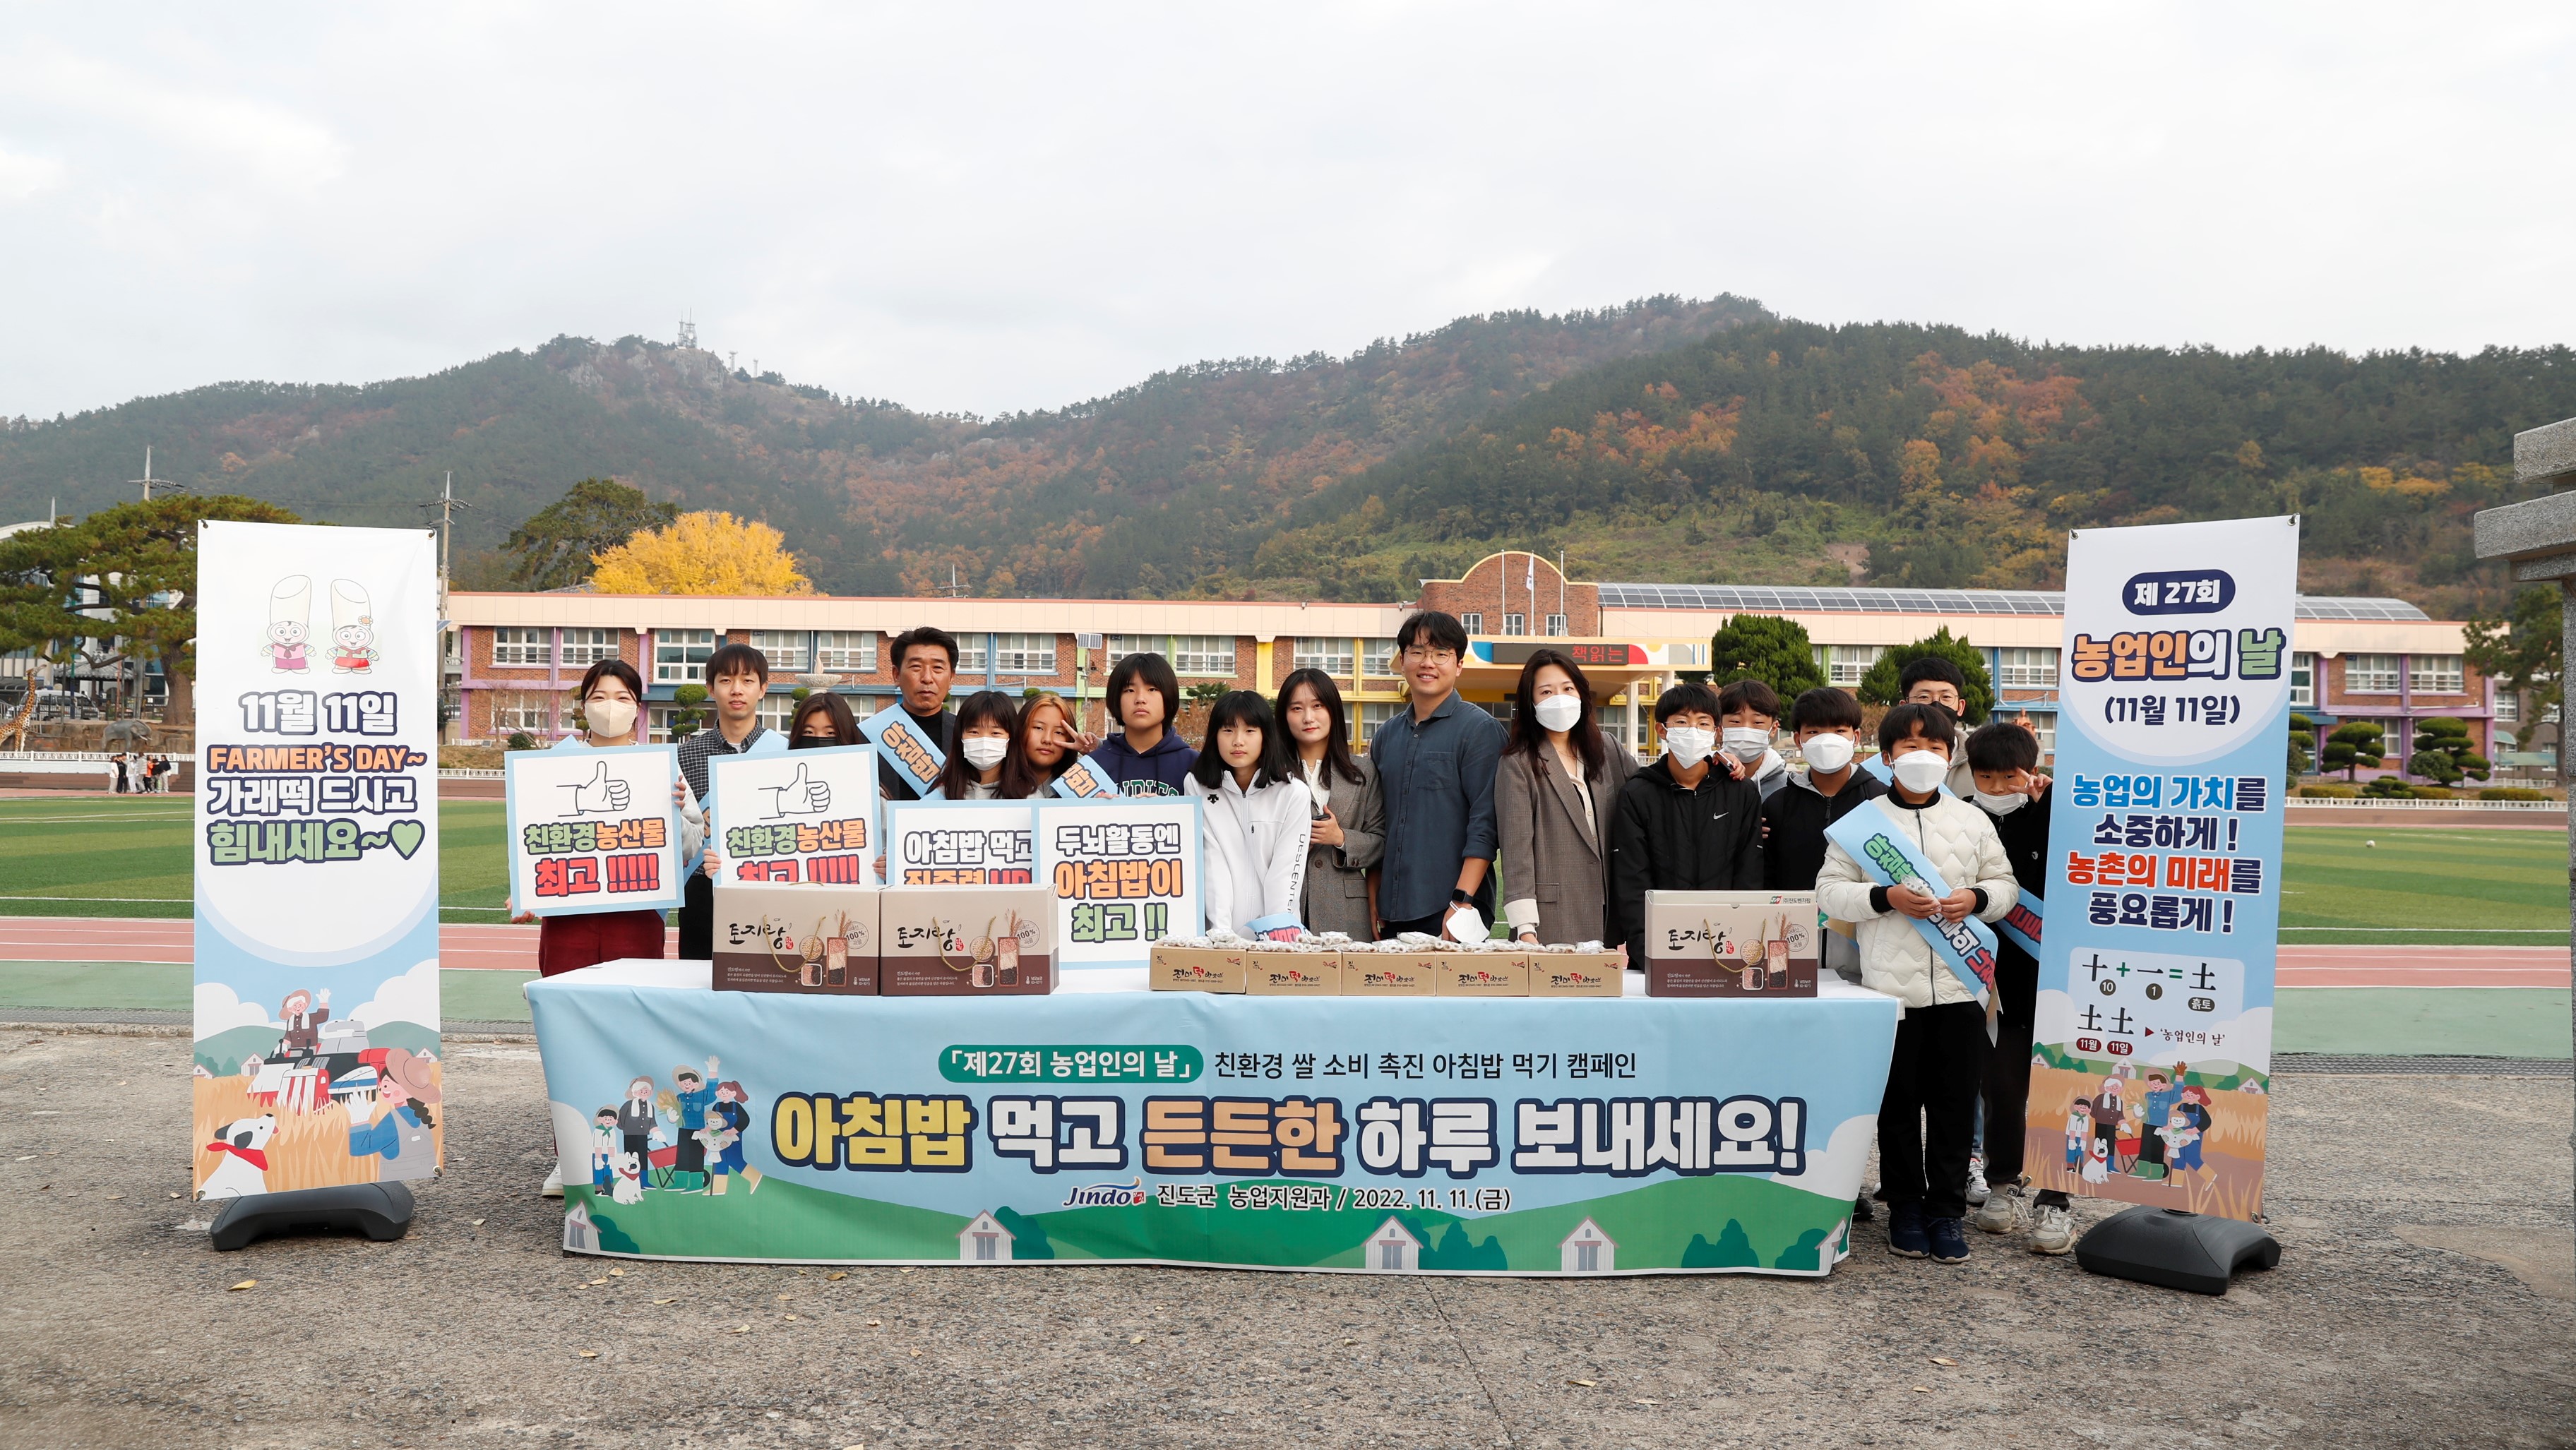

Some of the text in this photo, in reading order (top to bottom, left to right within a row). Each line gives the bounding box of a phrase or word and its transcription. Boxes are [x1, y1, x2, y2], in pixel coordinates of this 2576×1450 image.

[2134, 580, 2220, 606] 제 27회
[2072, 628, 2286, 682] 농업인의 날
[239, 690, 397, 735] 11월 11일
[2104, 695, 2241, 725] (11월 11일)
[208, 742, 427, 773] FARMER'S DAY~
[881, 721, 941, 784] 아침밥
[208, 777, 417, 815] 가래떡 드시고
[2072, 774, 2266, 812] 농업의 가치를
[523, 817, 667, 855] 친환경농산물
[726, 817, 867, 858] 친환경농산물
[904, 829, 986, 865] 아침밥
[1057, 823, 1181, 856] 두뇌활동엔
[2092, 814, 2217, 851] 소중하게
[535, 853, 660, 897] 최고 !!!!!
[1054, 859, 1183, 899] 아침밥이
[2066, 851, 2262, 895] 농촌의 미래를
[1071, 903, 1168, 943] 최고 !!
[2088, 892, 2214, 933] 풍요롭게
[846, 930, 864, 940] 100%
[1017, 929, 1036, 940] 100%
[1787, 933, 1805, 943] 100%
[2101, 981, 2158, 997] 10 1
[2190, 998, 2212, 1012] 흙토
[2080, 1038, 2129, 1054] 11월 11일
[951, 1050, 1637, 1079] 「제27회 농업인의 날」 친환경 쌀 소비 촉진 아침밥 먹기 캠페인
[771, 1091, 1807, 1179] 아침밥 먹고 든든한 하루 보내세요!
[1063, 1187, 1132, 1206] Jindo
[1157, 1185, 1216, 1208] 진도군
[1229, 1185, 1330, 1209] 농업지원과
[1335, 1188, 1345, 1210] /
[1354, 1188, 1411, 1209] 2022.
[1418, 1189, 1442, 1209] 11.
[1449, 1188, 1511, 1211] 11.(금)
